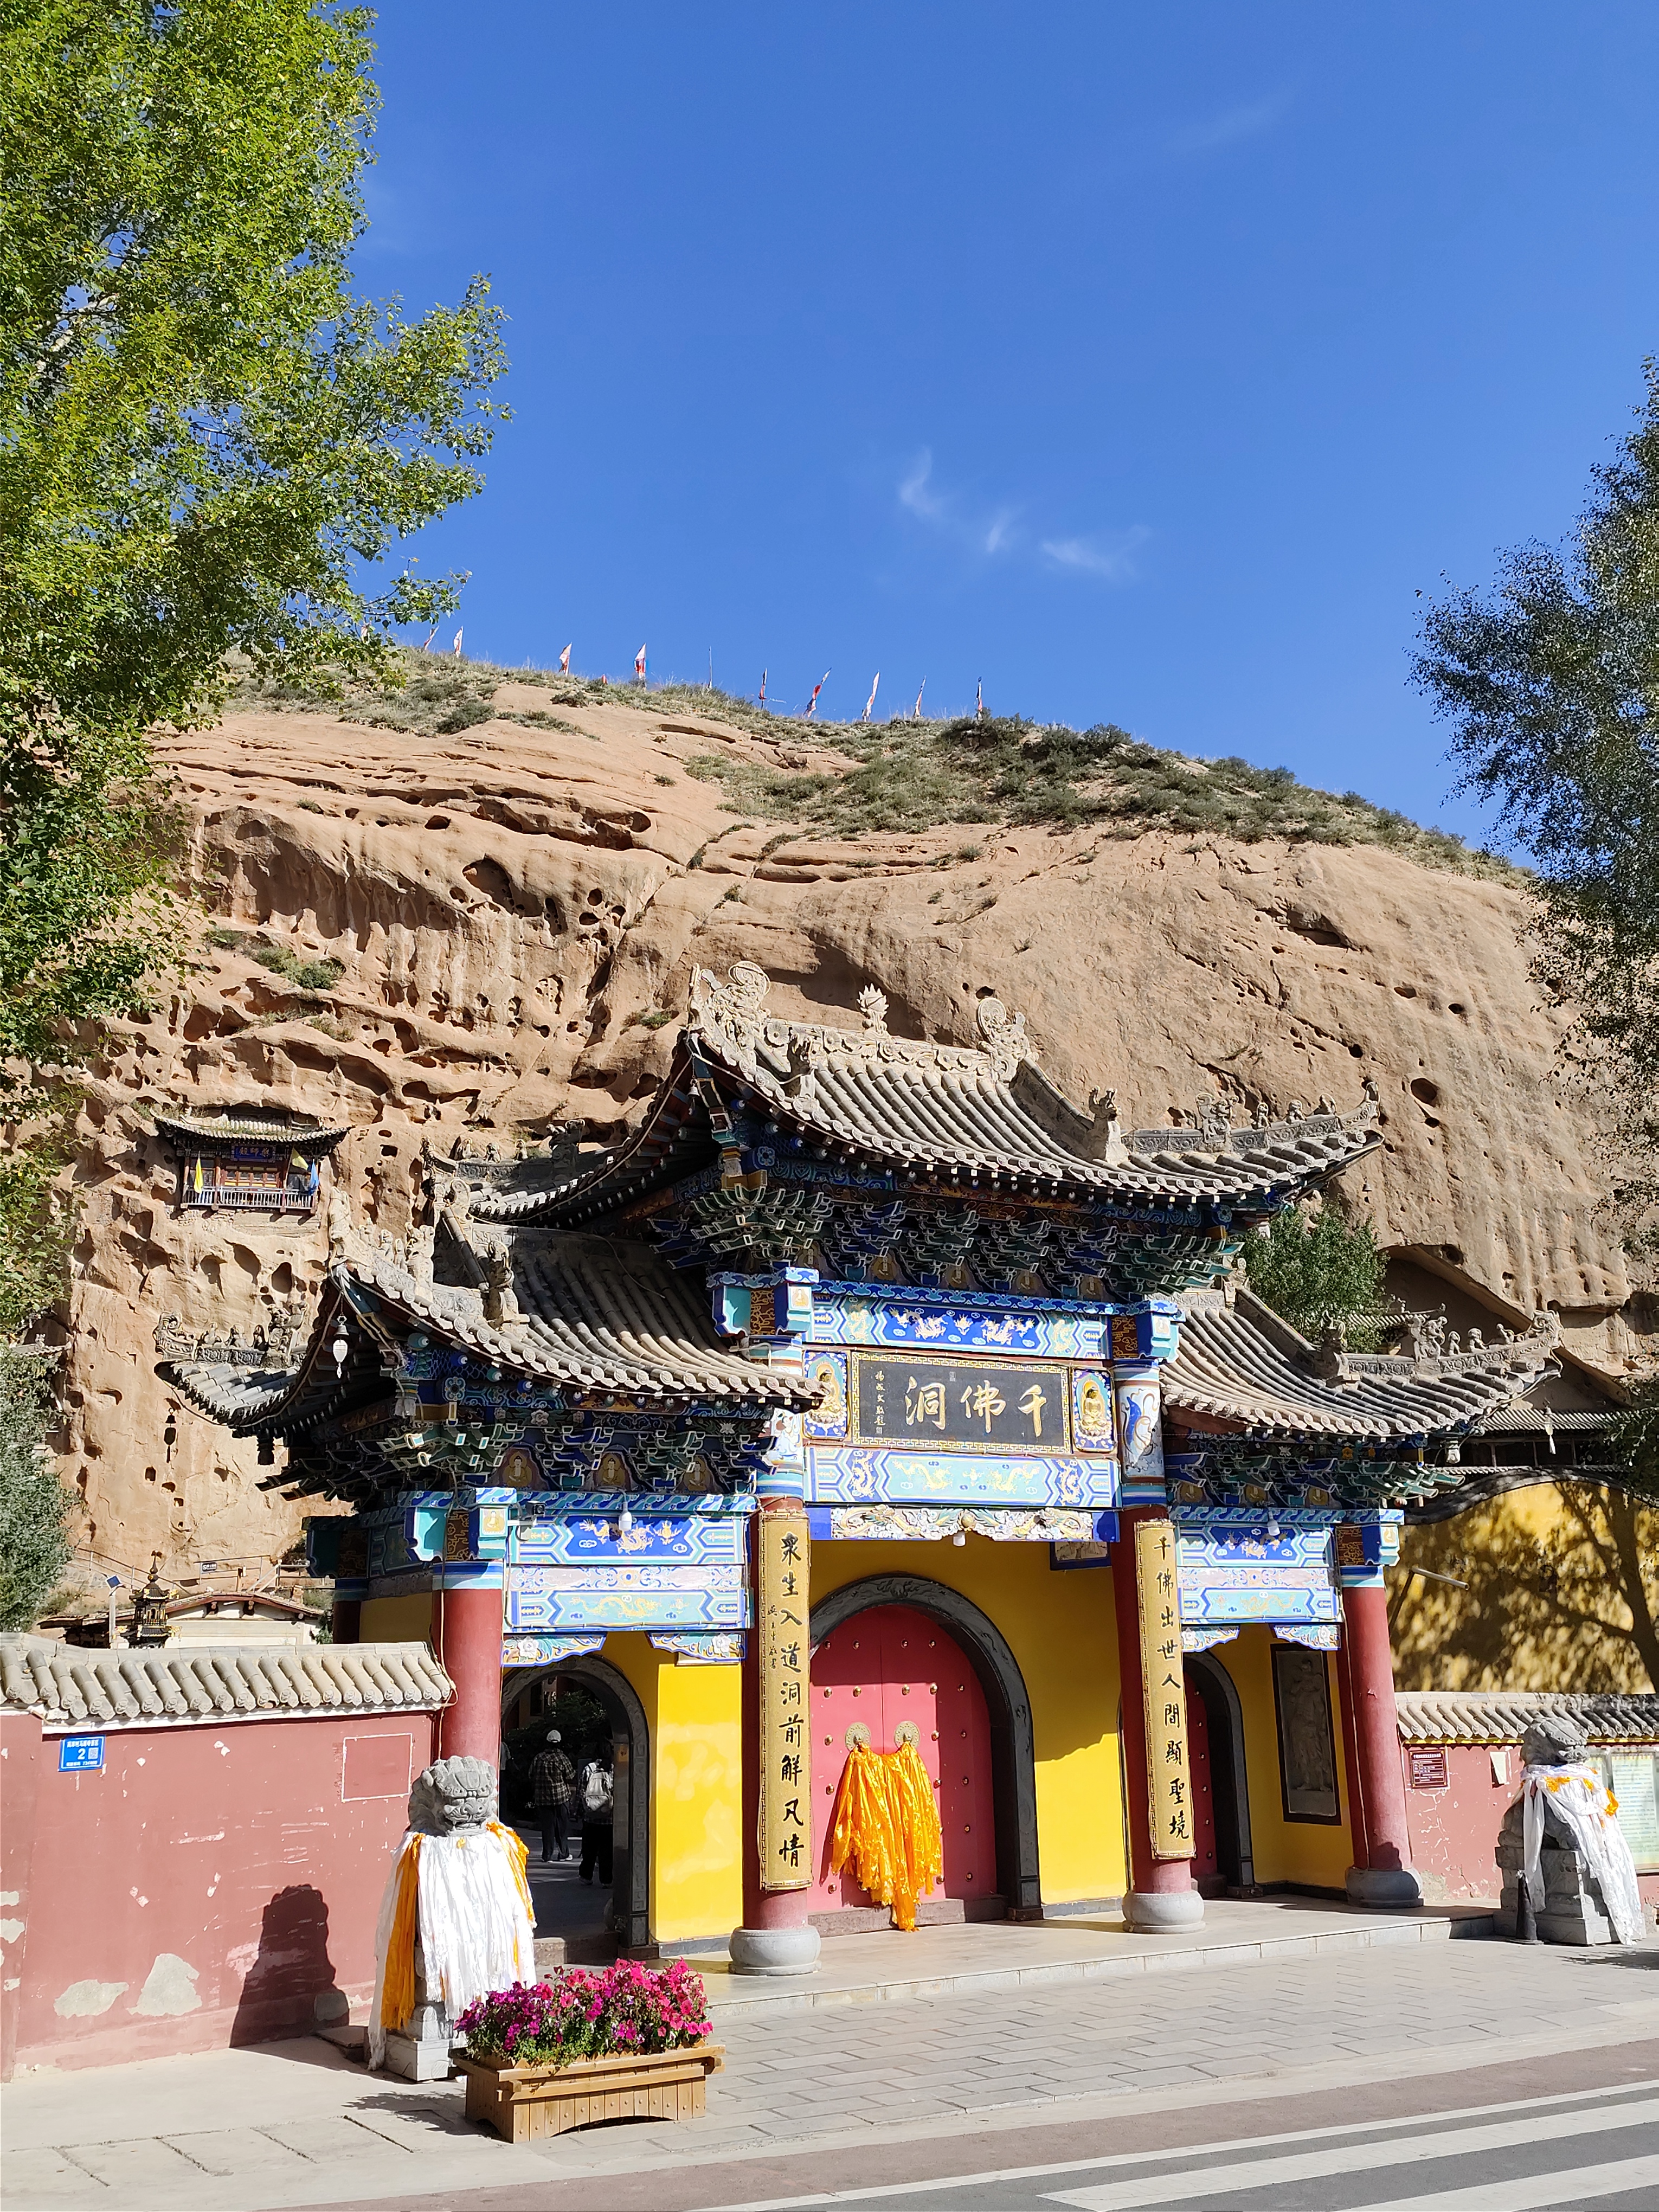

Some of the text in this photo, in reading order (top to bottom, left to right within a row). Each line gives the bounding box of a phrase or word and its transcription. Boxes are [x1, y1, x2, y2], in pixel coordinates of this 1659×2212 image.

[904, 1375, 1047, 1438] 千佛洞
[1153, 1535, 1189, 1840] 千佛出世人間顯聖境
[77, 1748, 86, 1759] 2
